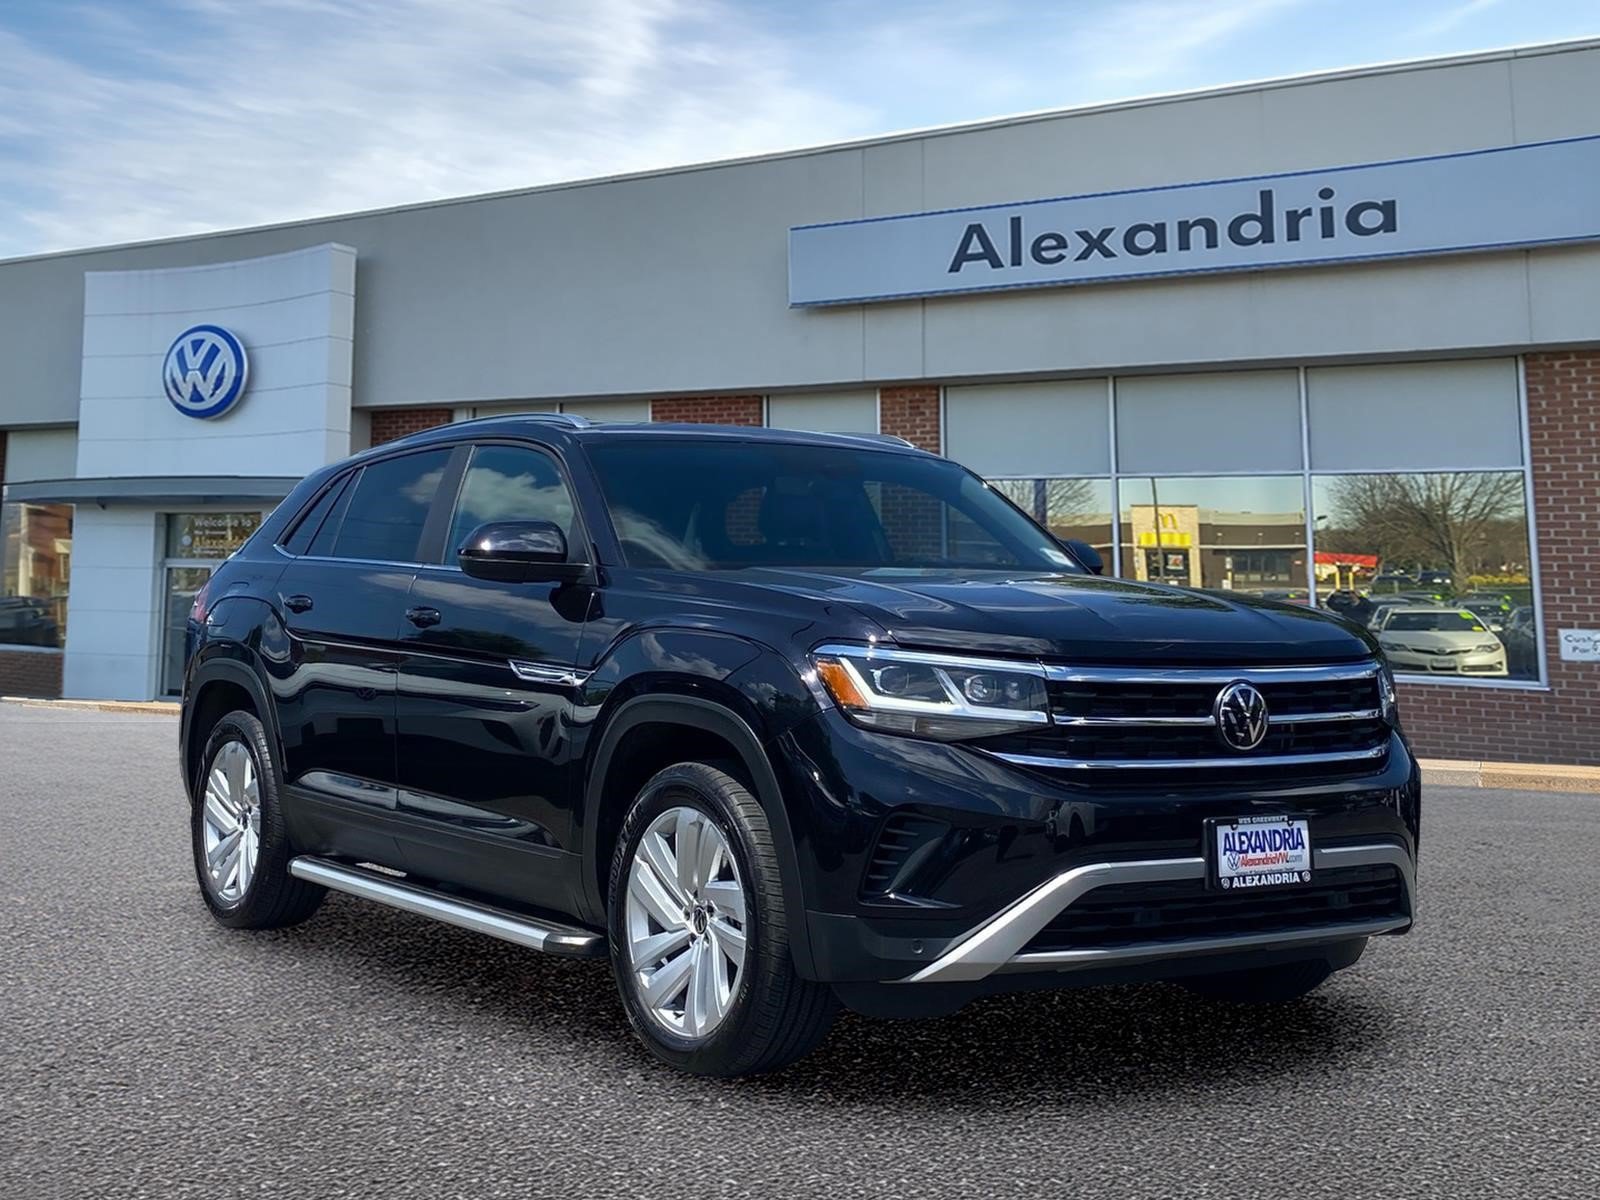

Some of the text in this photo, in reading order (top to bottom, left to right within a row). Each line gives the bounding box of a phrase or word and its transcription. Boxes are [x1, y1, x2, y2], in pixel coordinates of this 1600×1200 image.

[948, 187, 1398, 273] Alexandria
[1223, 828, 1305, 856] ALEXANDRIA
[1232, 872, 1300, 888] ALEXANDRIA
